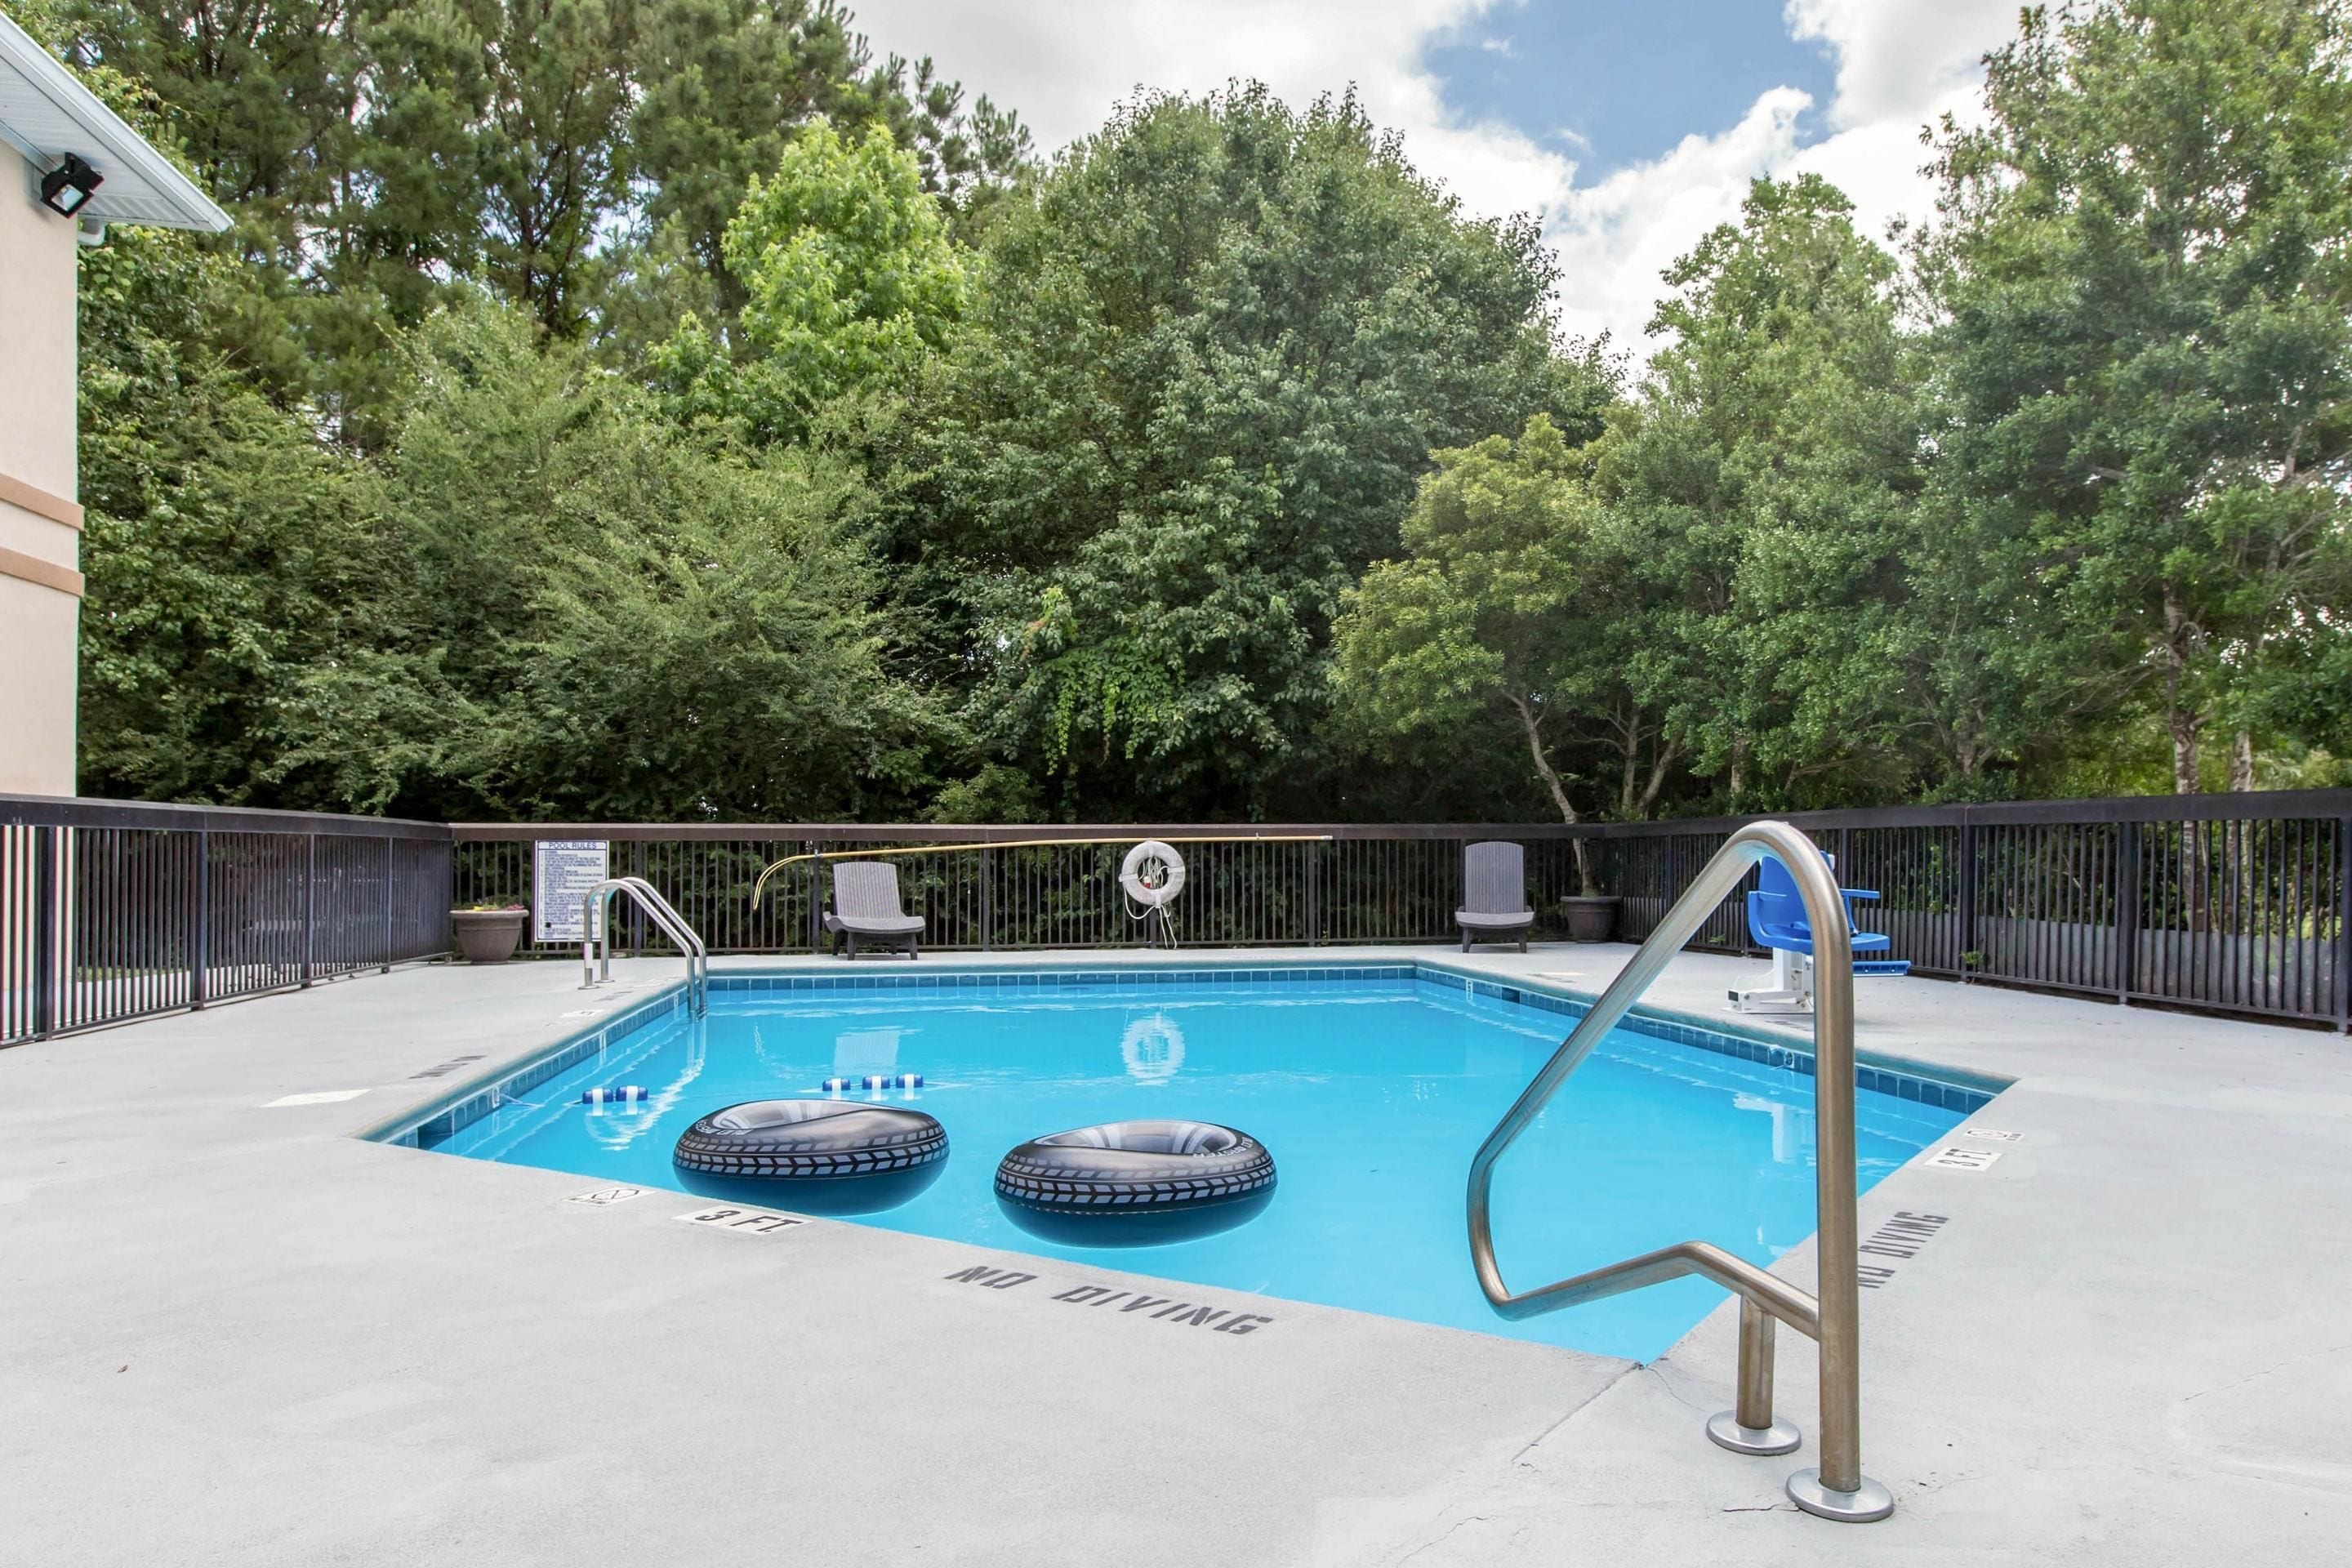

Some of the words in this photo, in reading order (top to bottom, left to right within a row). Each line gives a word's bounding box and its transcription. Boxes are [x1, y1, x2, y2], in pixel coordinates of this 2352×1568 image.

[694, 1210, 741, 1221] 3
[1858, 1211, 1949, 1258] DIVING
[943, 1266, 1039, 1290] NO
[1050, 1285, 1274, 1335] DIVING
